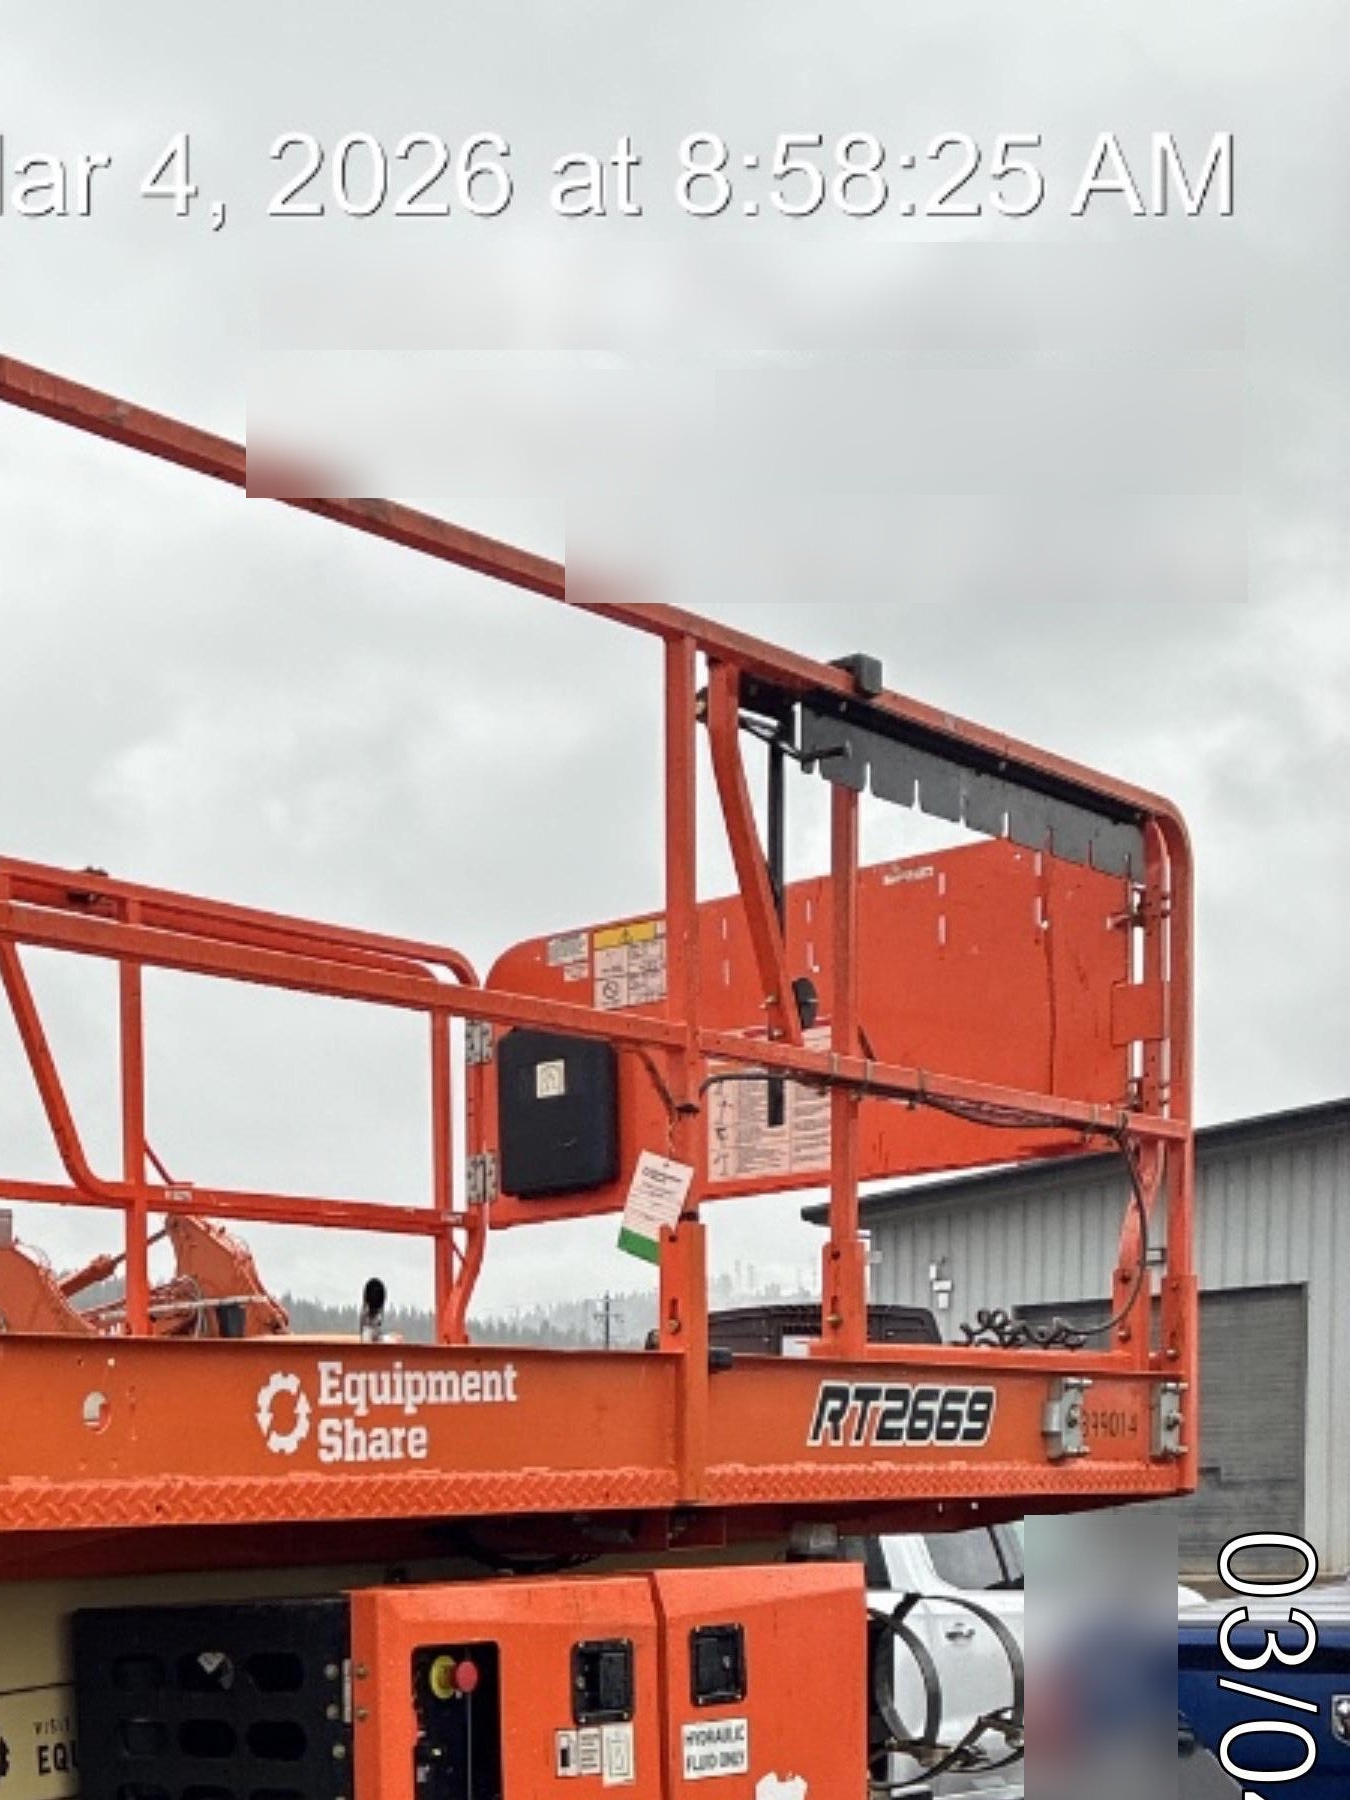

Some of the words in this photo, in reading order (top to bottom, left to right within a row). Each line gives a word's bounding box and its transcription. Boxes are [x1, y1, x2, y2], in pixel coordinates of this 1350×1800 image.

[317, 1361, 517, 1416] Equipment
[807, 1380, 996, 1447] RT2669
[317, 1417, 428, 1463] Share
